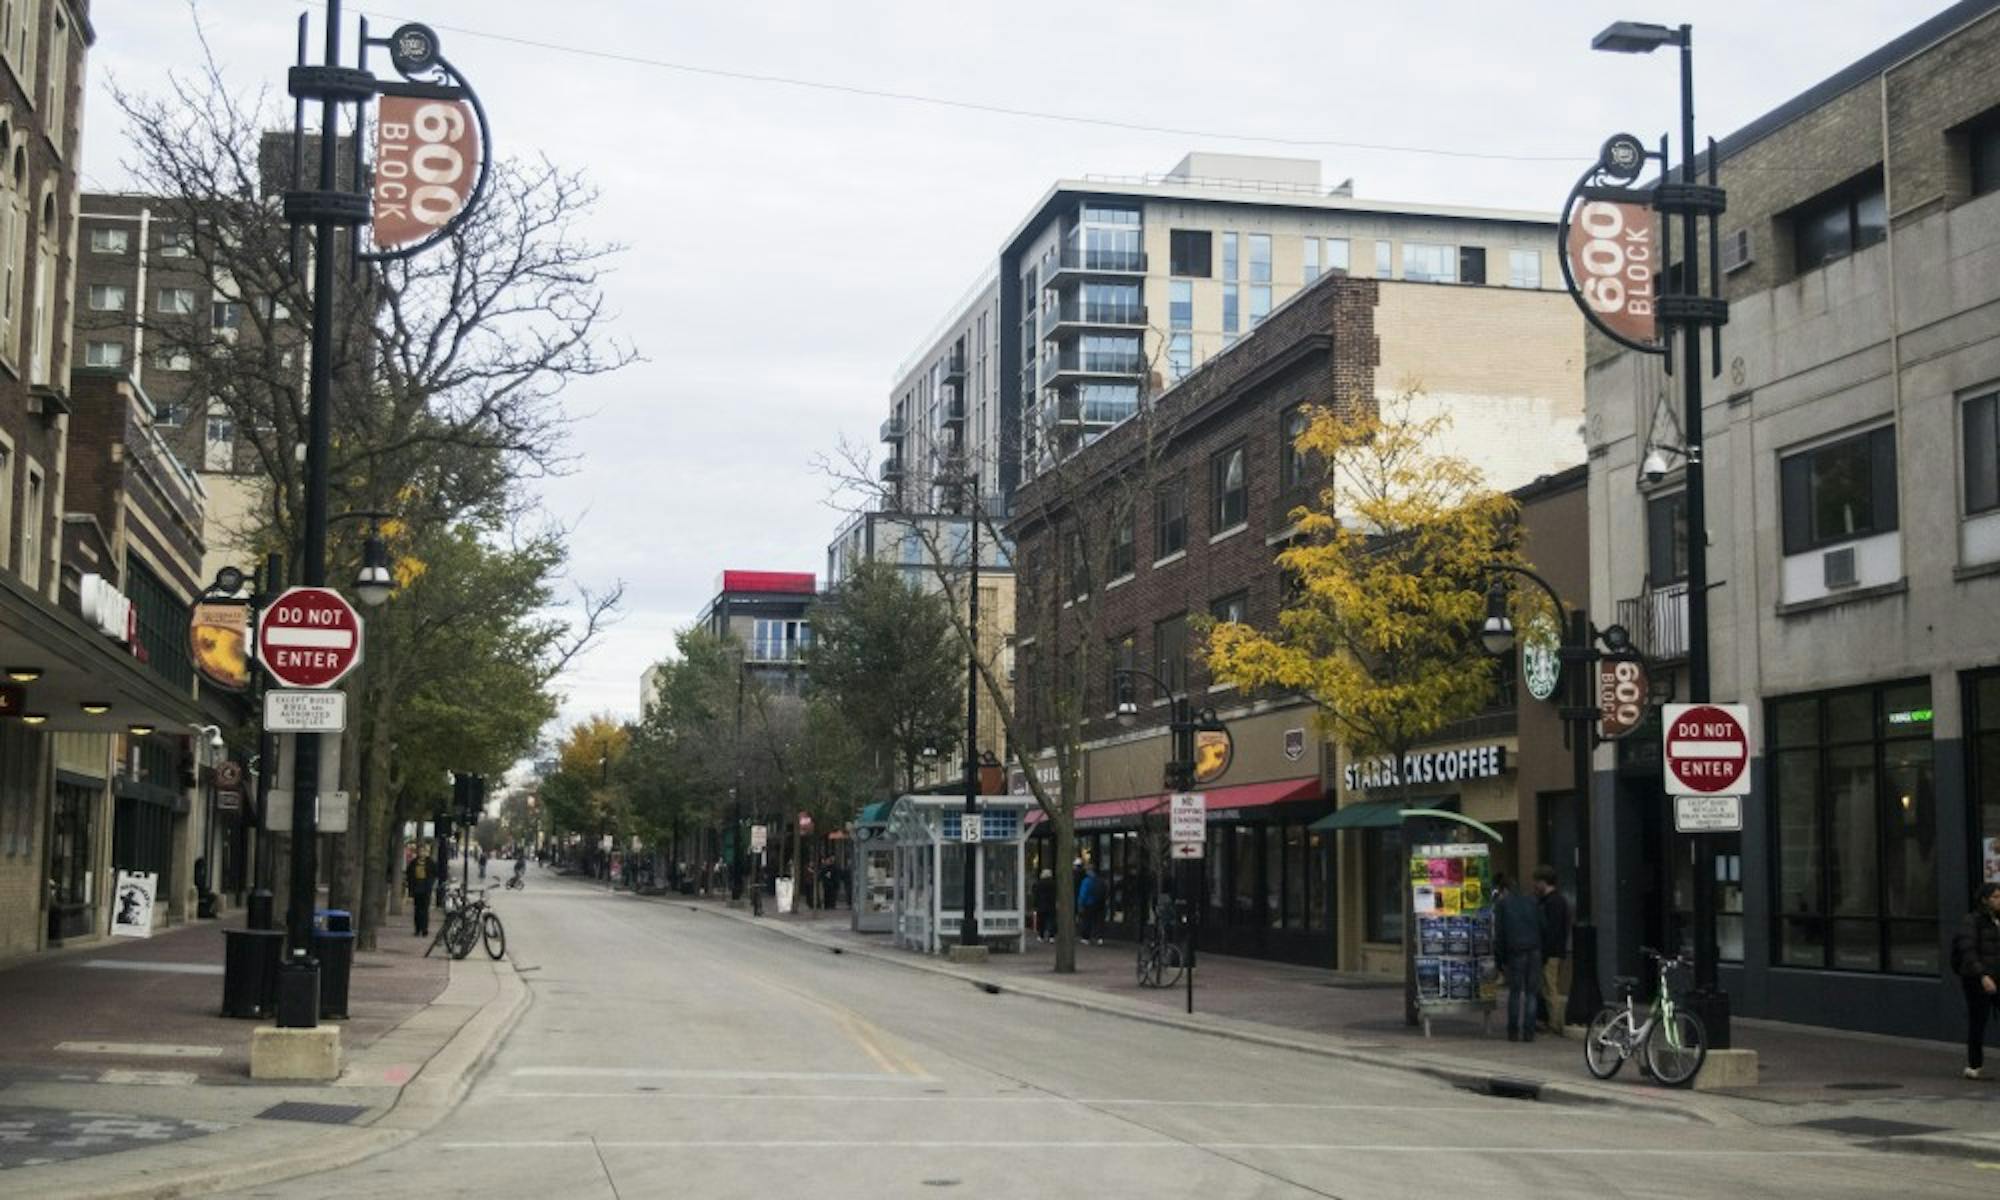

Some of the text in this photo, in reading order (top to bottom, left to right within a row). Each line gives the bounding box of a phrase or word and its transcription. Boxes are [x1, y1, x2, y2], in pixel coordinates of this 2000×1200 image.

[377, 122, 410, 221] BLOCK
[411, 104, 465, 225] 600
[1581, 201, 1625, 313] 600
[1624, 226, 1651, 316] BLOCK
[278, 606, 344, 626] DO NOT
[276, 650, 340, 668] ENTER
[1601, 672, 1616, 723] BLOCK
[1615, 661, 1640, 726] 600
[1678, 722, 1734, 738] DO NOT
[1435, 745, 1500, 780] COFFEE
[1680, 760, 1734, 777] ENTER
[965, 828, 979, 841] 15
